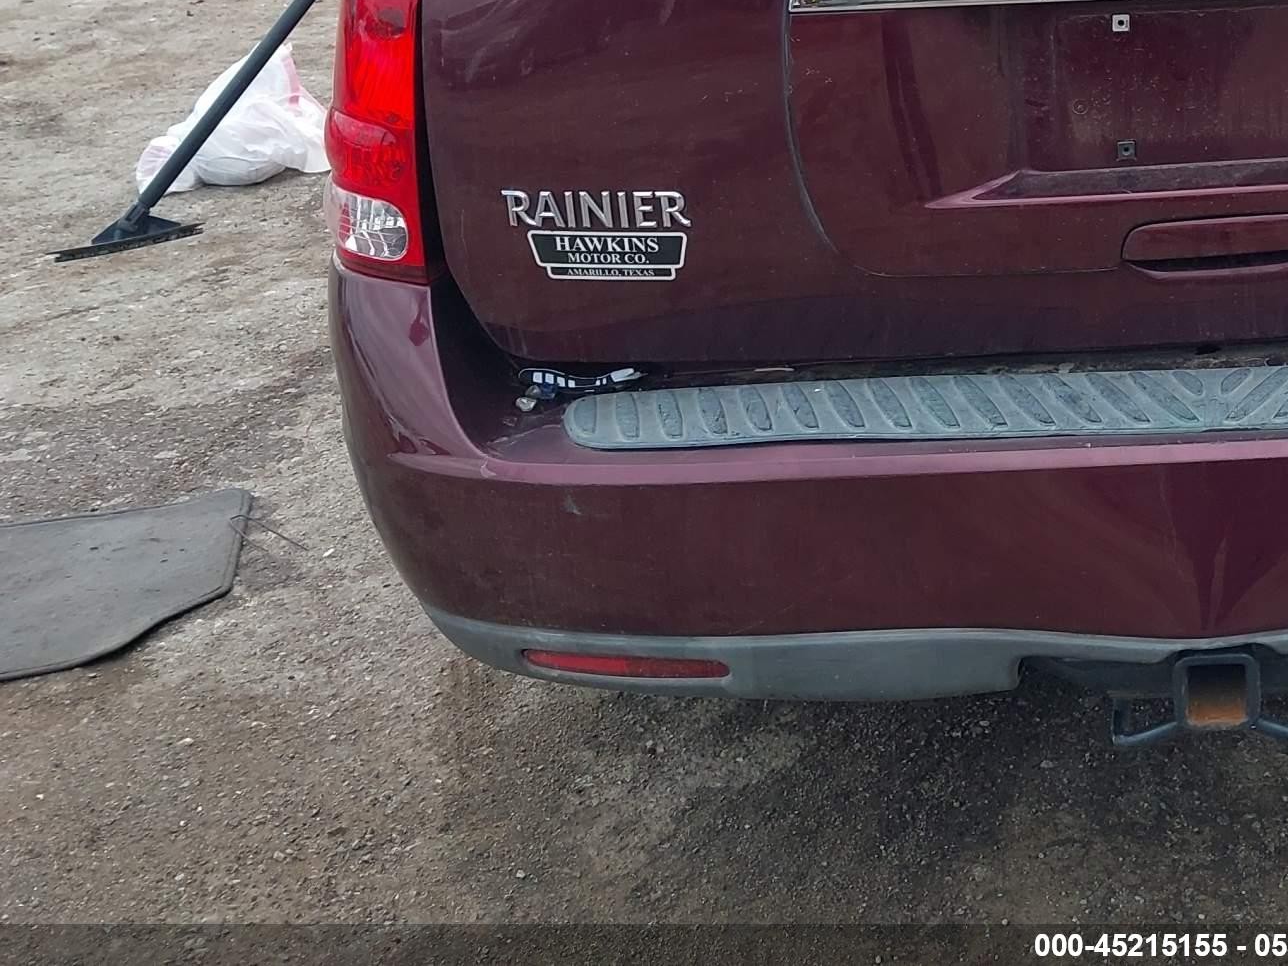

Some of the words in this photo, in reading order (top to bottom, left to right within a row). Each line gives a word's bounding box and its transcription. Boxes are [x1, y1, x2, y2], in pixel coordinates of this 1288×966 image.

[501, 190, 692, 228] RAINIER
[555, 236, 659, 252] HAWKINS
[568, 252, 621, 264] MOTOR
[624, 253, 650, 264] CO.
[567, 268, 621, 277] AMARILLO,
